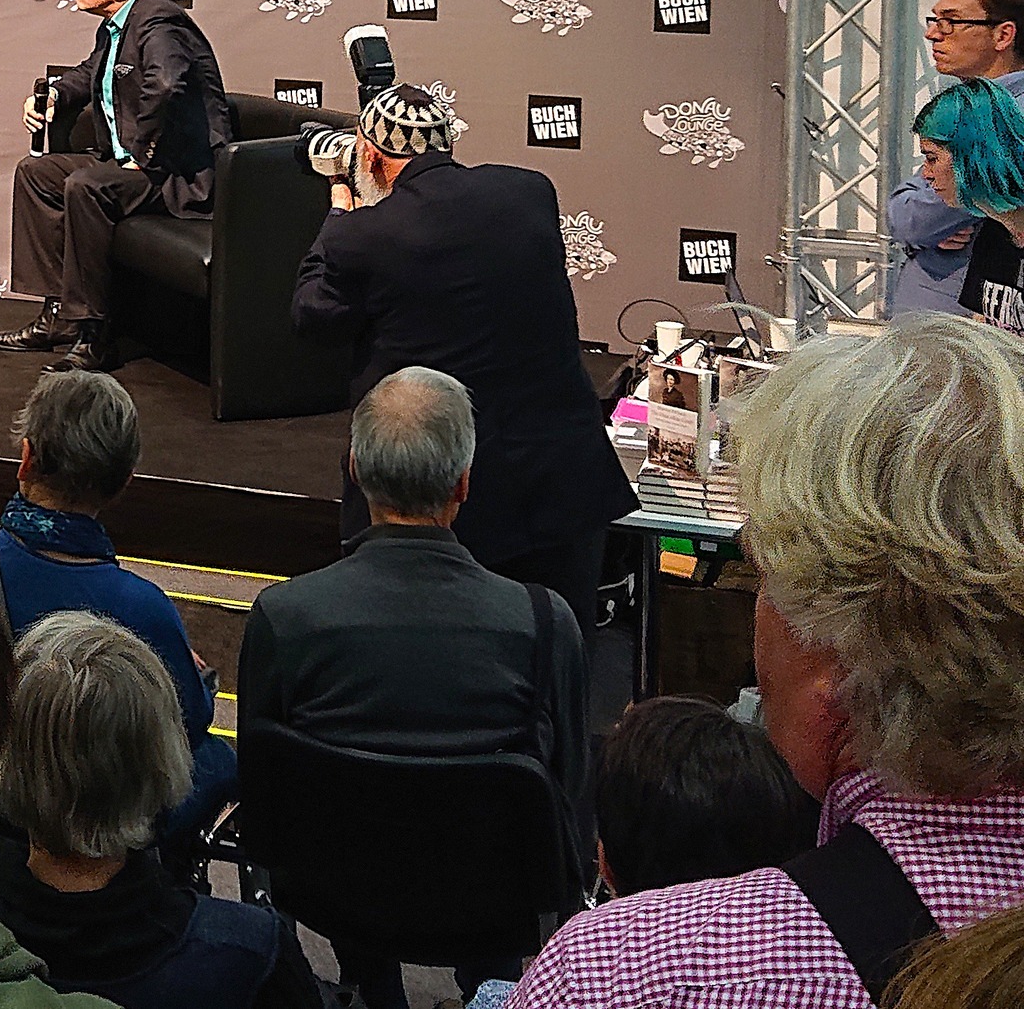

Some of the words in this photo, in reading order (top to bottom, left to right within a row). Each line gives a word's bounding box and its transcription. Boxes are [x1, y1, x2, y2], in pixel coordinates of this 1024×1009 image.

[660, 5, 708, 26] WIEN
[531, 104, 576, 124] BUCH
[659, 97, 731, 120] DONAU
[533, 121, 579, 140] WIEN
[683, 239, 730, 258] BUCH
